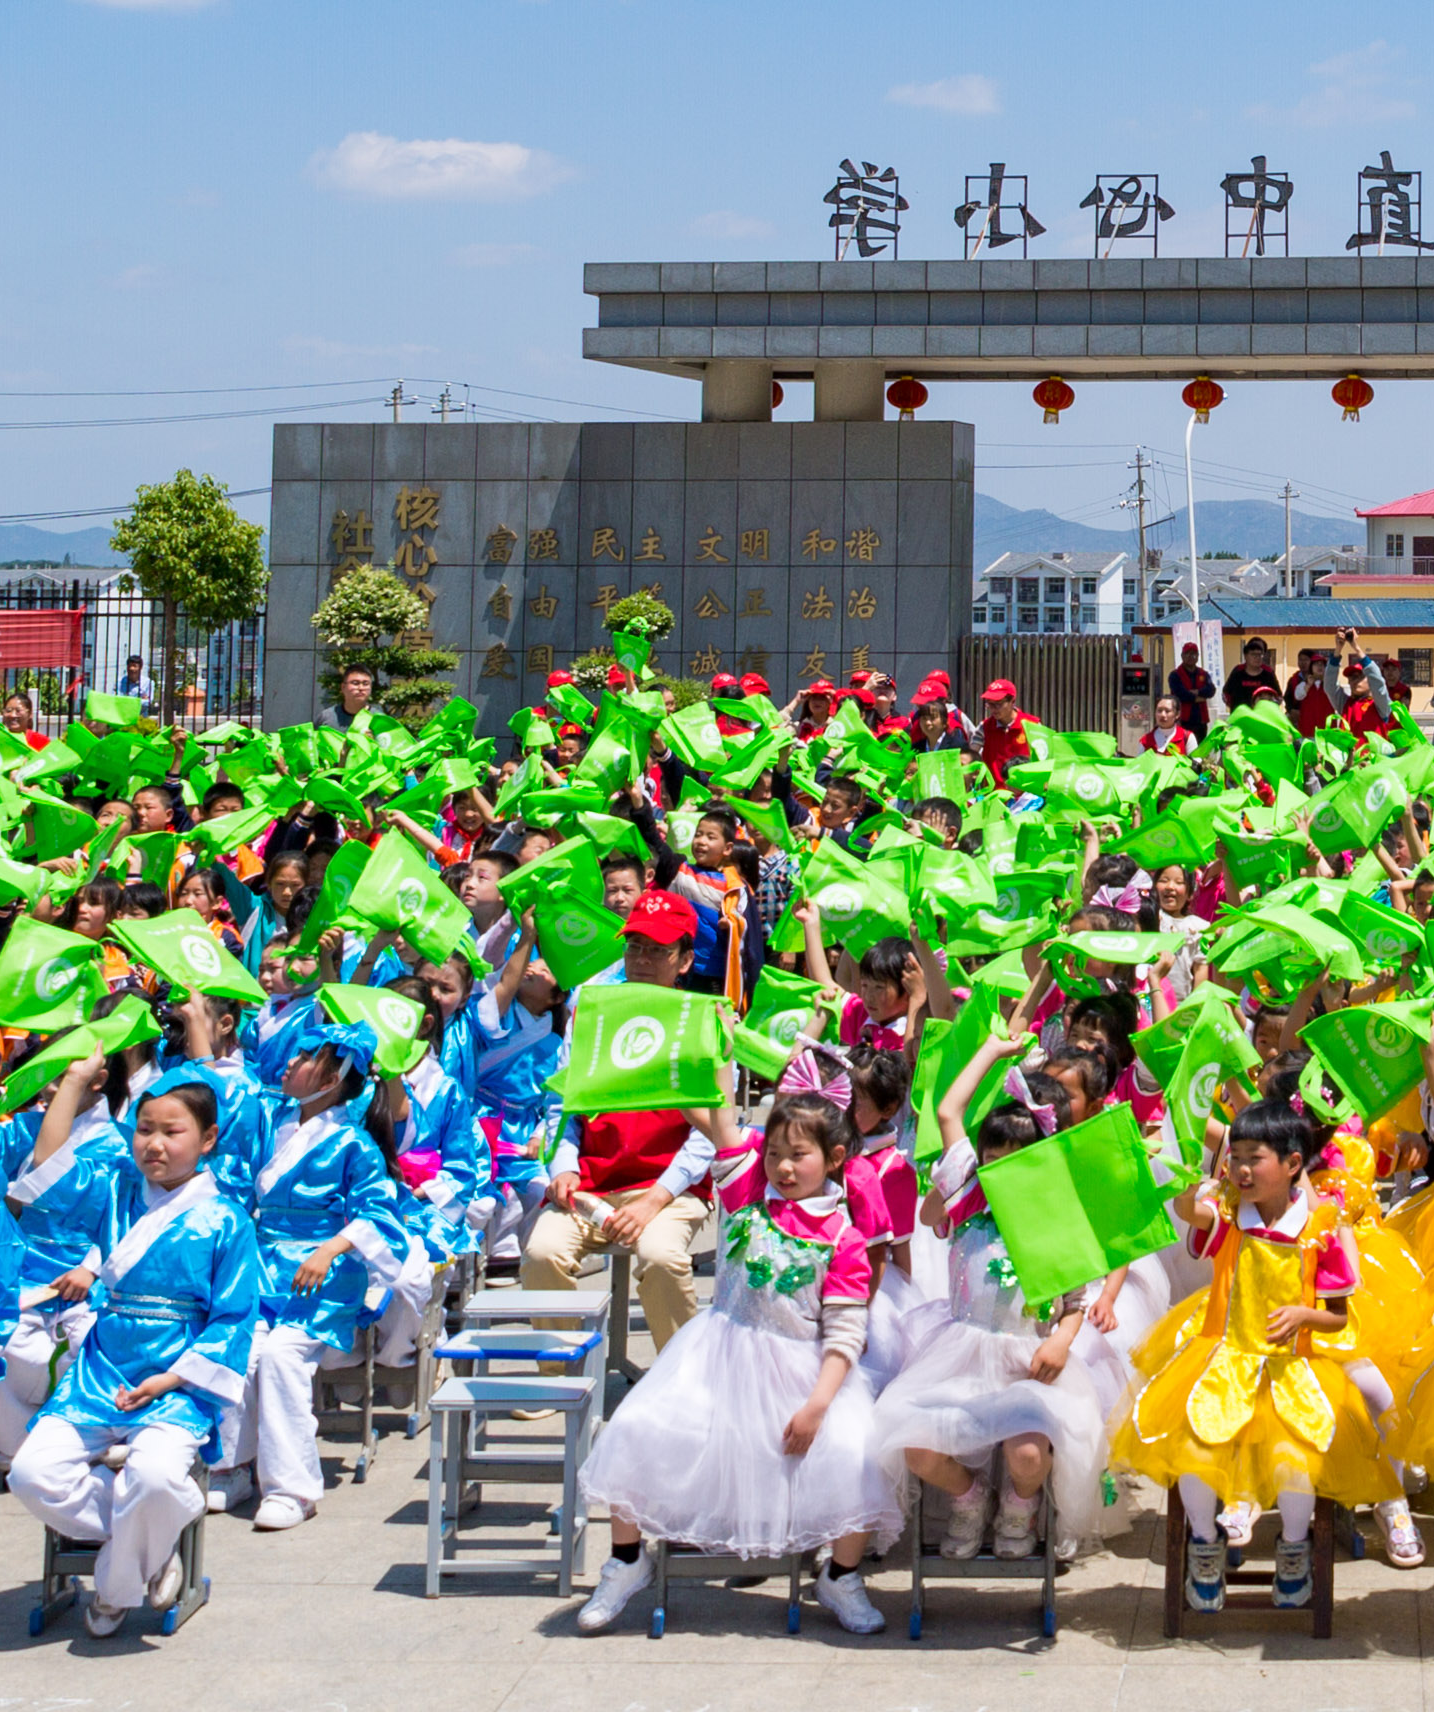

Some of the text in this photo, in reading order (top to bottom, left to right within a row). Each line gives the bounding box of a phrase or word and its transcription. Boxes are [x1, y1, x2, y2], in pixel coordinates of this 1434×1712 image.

[487, 524, 881, 563] 富强 民主 文明 和谐
[488, 584, 559, 621] 自由
[694, 588, 772, 619] 公正
[802, 586, 877, 619] 法治
[482, 642, 554, 680] 爱国
[689, 643, 771, 675] 诚信
